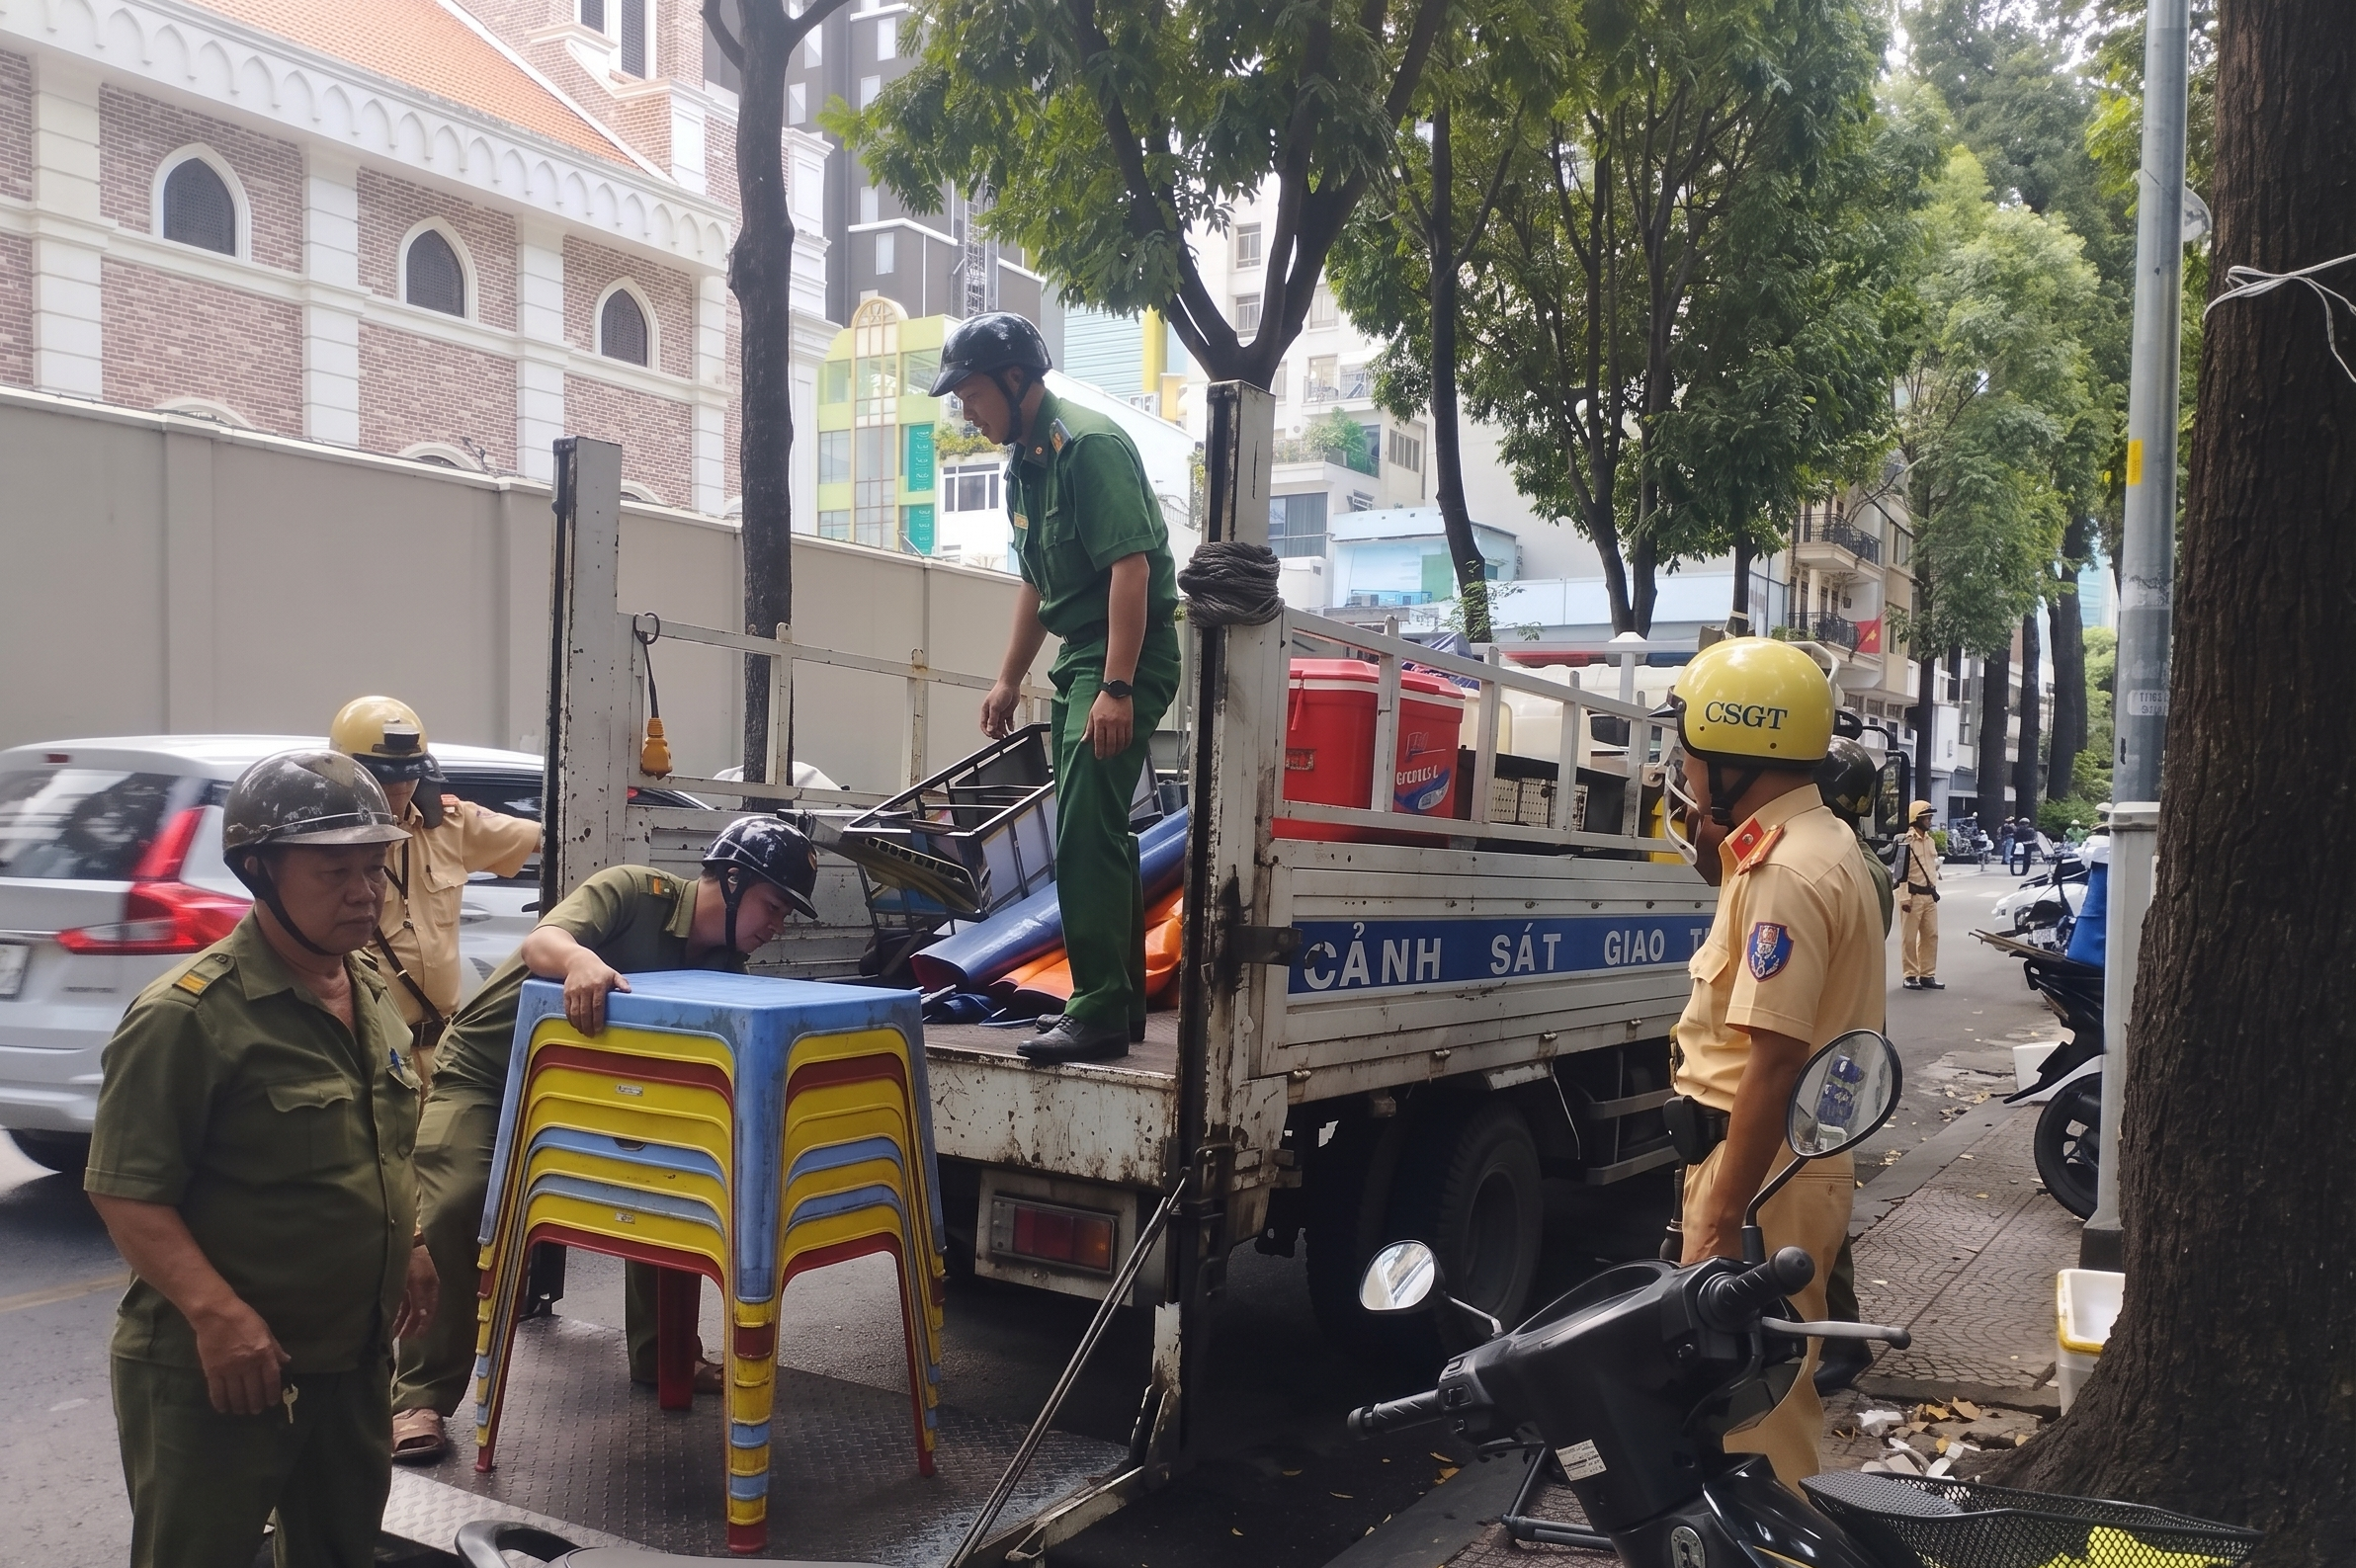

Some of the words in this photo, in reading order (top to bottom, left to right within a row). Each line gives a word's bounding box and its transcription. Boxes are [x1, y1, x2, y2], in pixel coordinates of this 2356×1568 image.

[1705, 701, 1789, 730] CSGT
[1304, 922, 1442, 990] CẢNH
[1490, 923, 1561, 975] SÁT
[1604, 929, 1665, 965] GIAO
